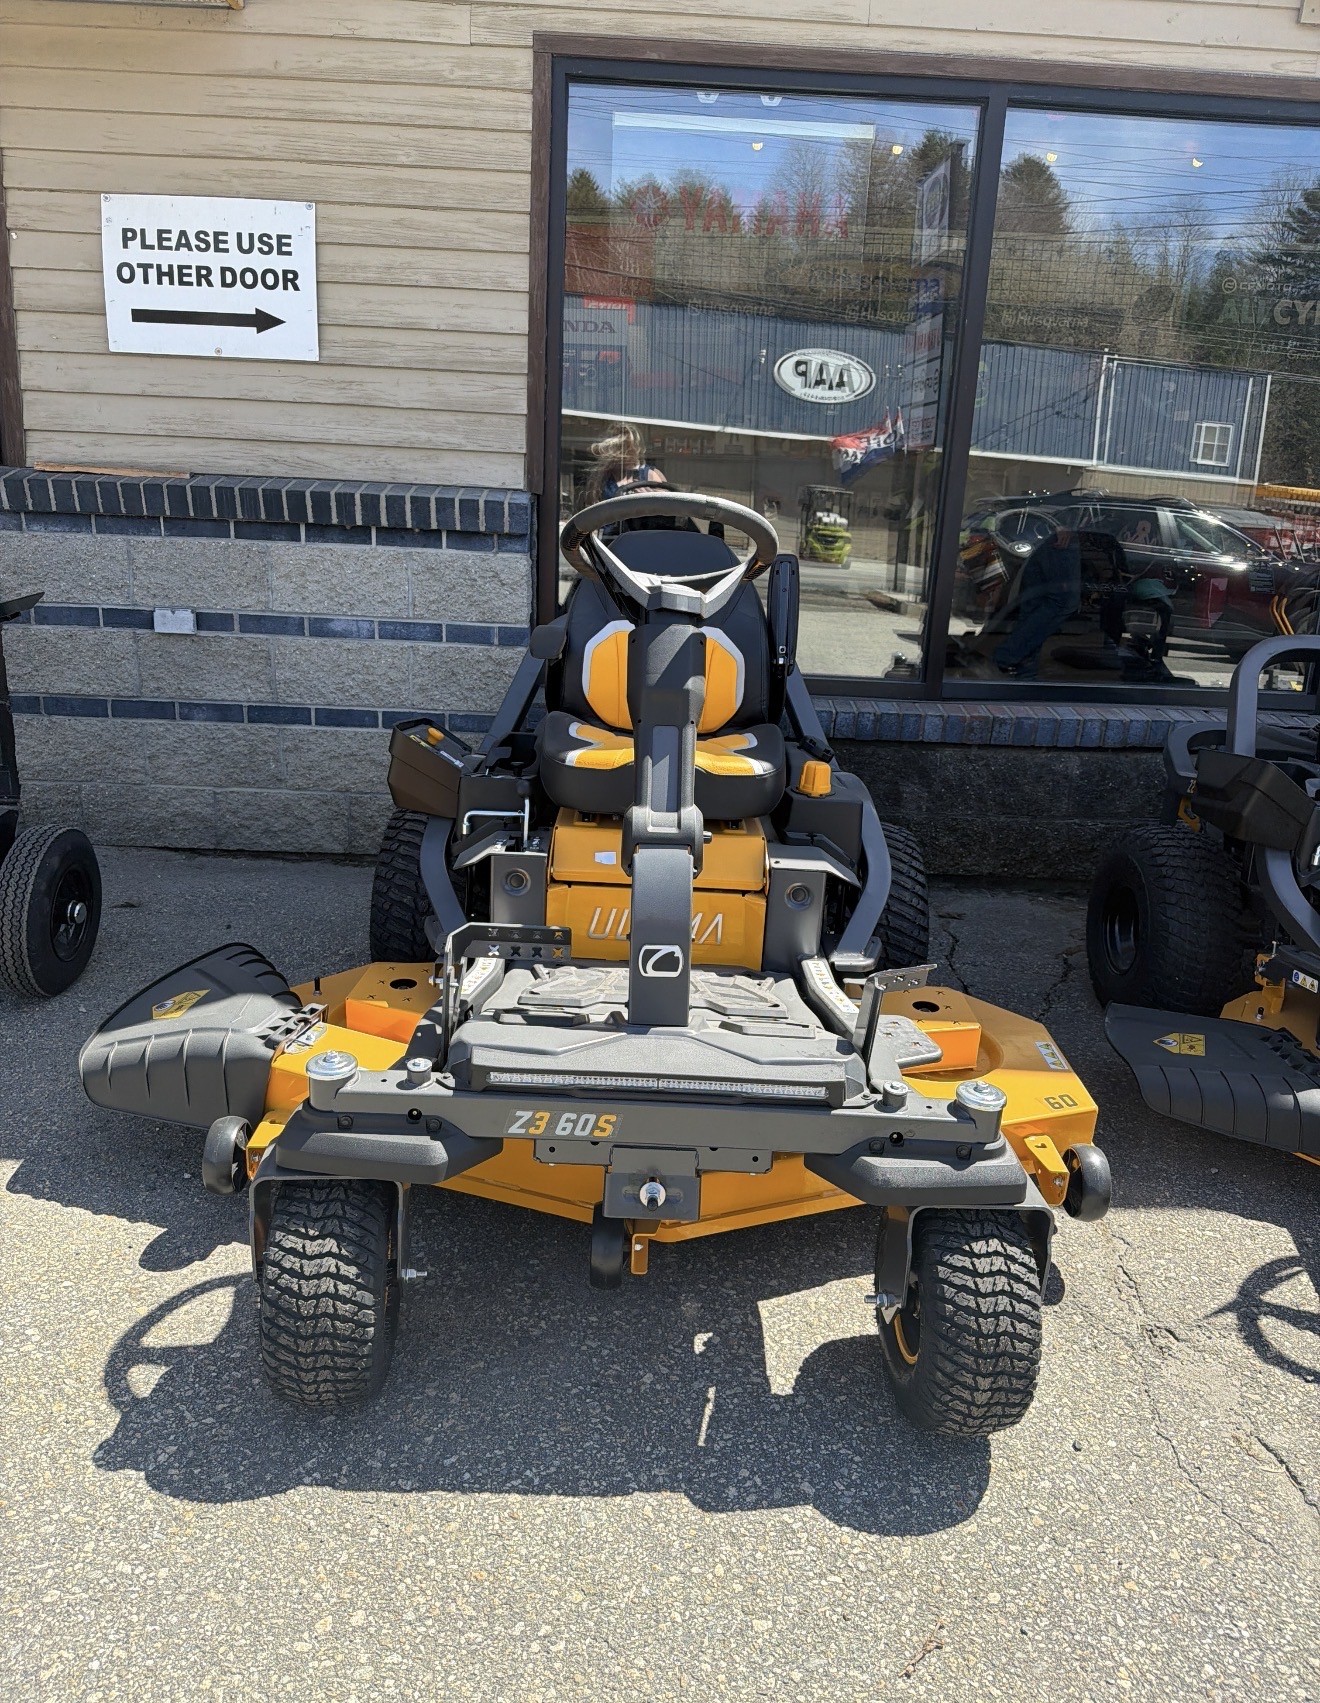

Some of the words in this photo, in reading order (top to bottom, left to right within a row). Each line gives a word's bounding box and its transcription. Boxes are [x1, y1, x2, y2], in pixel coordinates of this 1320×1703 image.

[679, 186, 849, 238] YAMAHA
[121, 227, 230, 254] PLEASE
[236, 231, 293, 257] USE
[116, 261, 214, 288] OTHER
[220, 265, 301, 292] DOOR
[1043, 1093, 1079, 1110] 60
[507, 1110, 551, 1135] Z3
[554, 1112, 617, 1137] 60S
